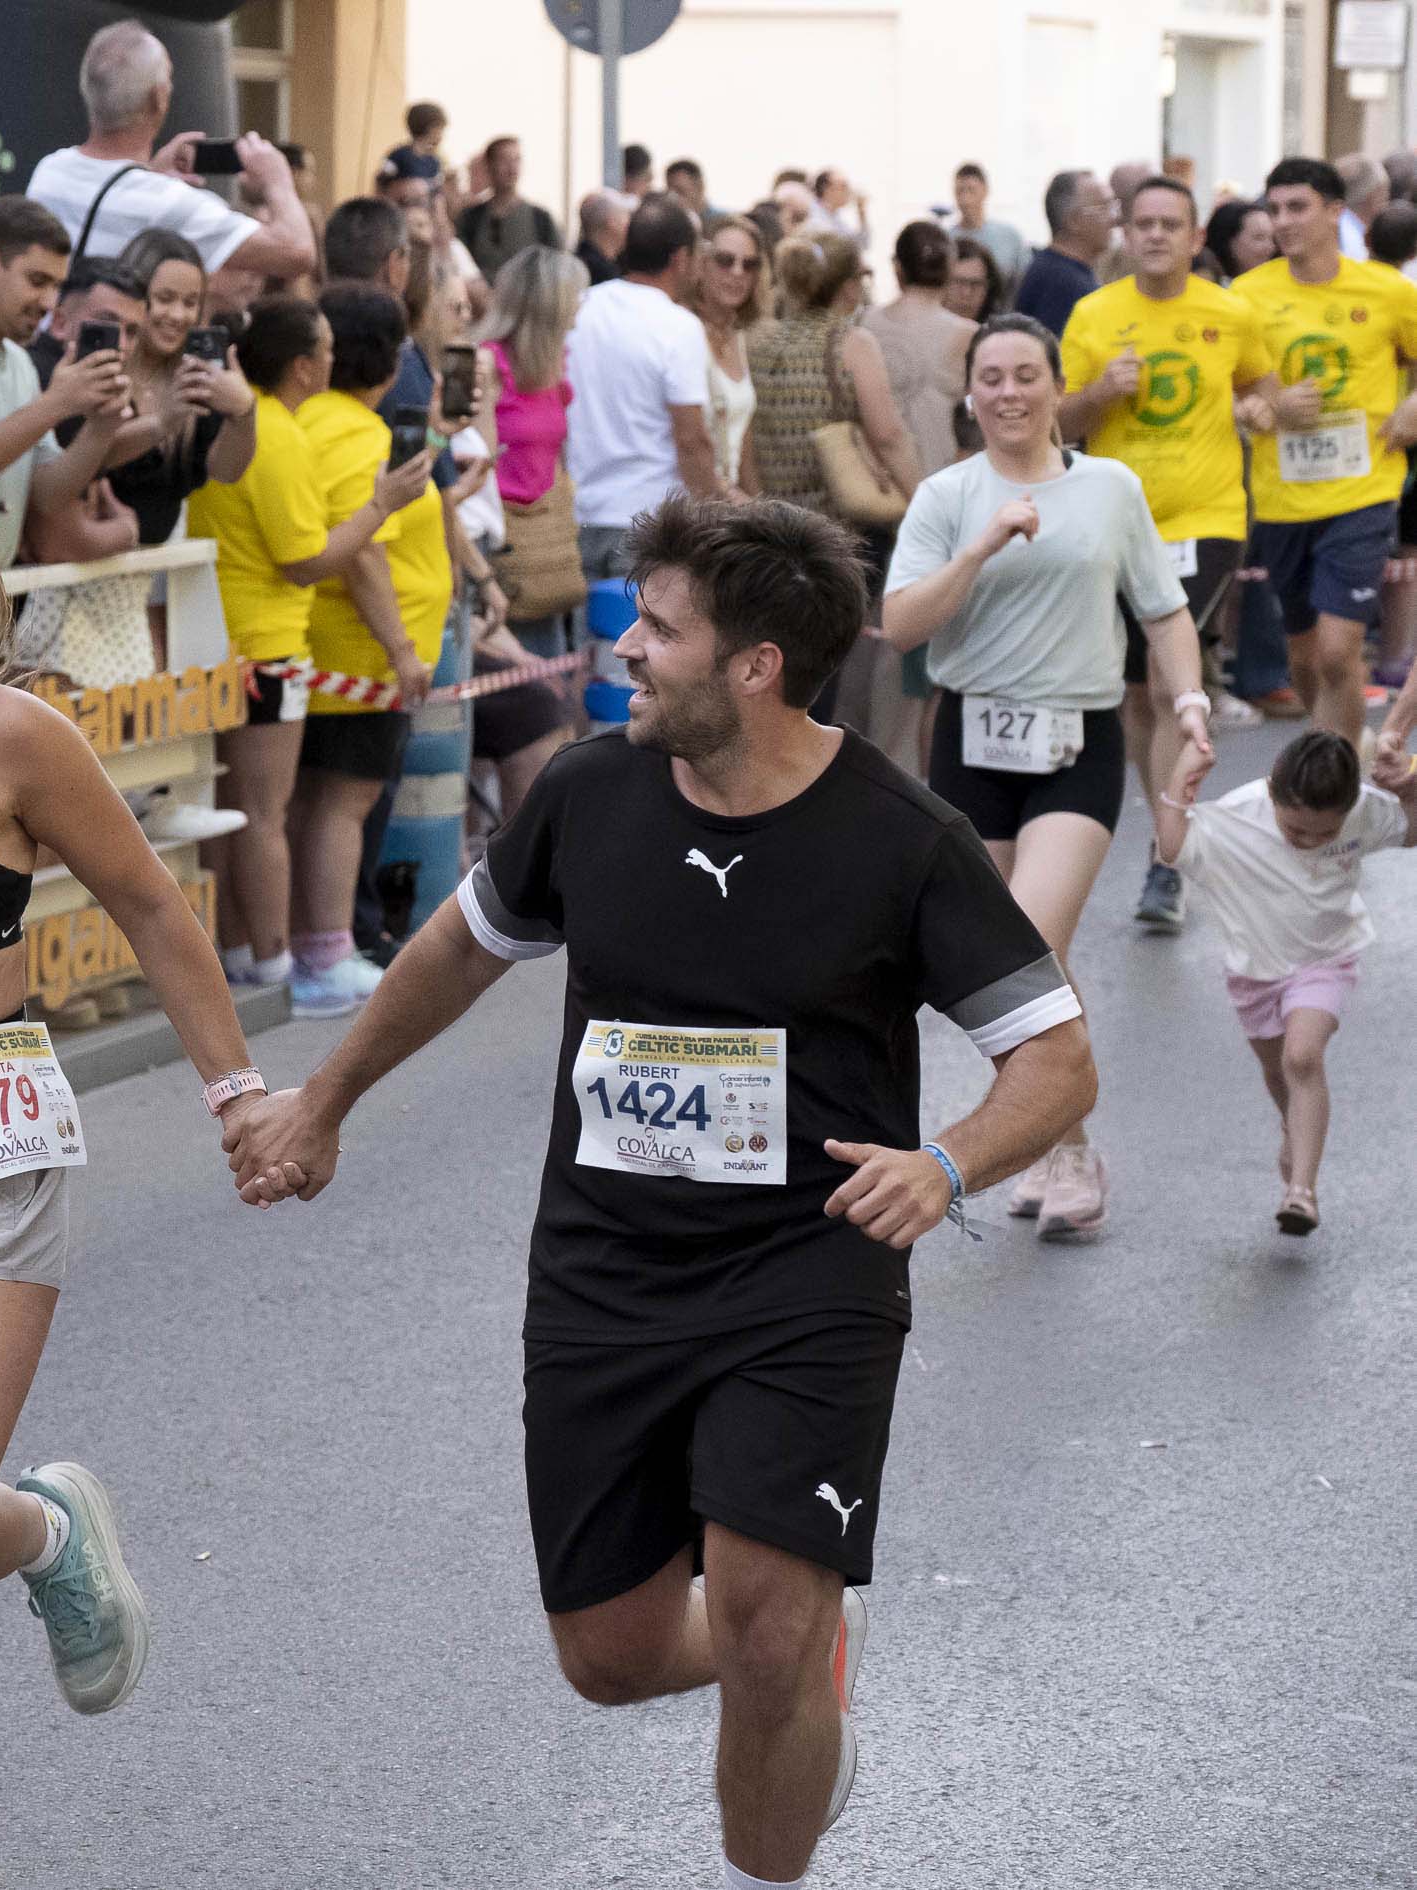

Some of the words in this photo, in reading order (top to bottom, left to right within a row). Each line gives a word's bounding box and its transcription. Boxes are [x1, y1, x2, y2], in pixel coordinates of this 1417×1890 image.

[979, 707, 1037, 740] 127
[628, 1040, 681, 1054] CELTIC
[683, 1041, 759, 1057] SUBMARÍ
[619, 1065, 680, 1079] RUBERT
[587, 1077, 712, 1131] 1424
[617, 1136, 696, 1162] COVALCA
